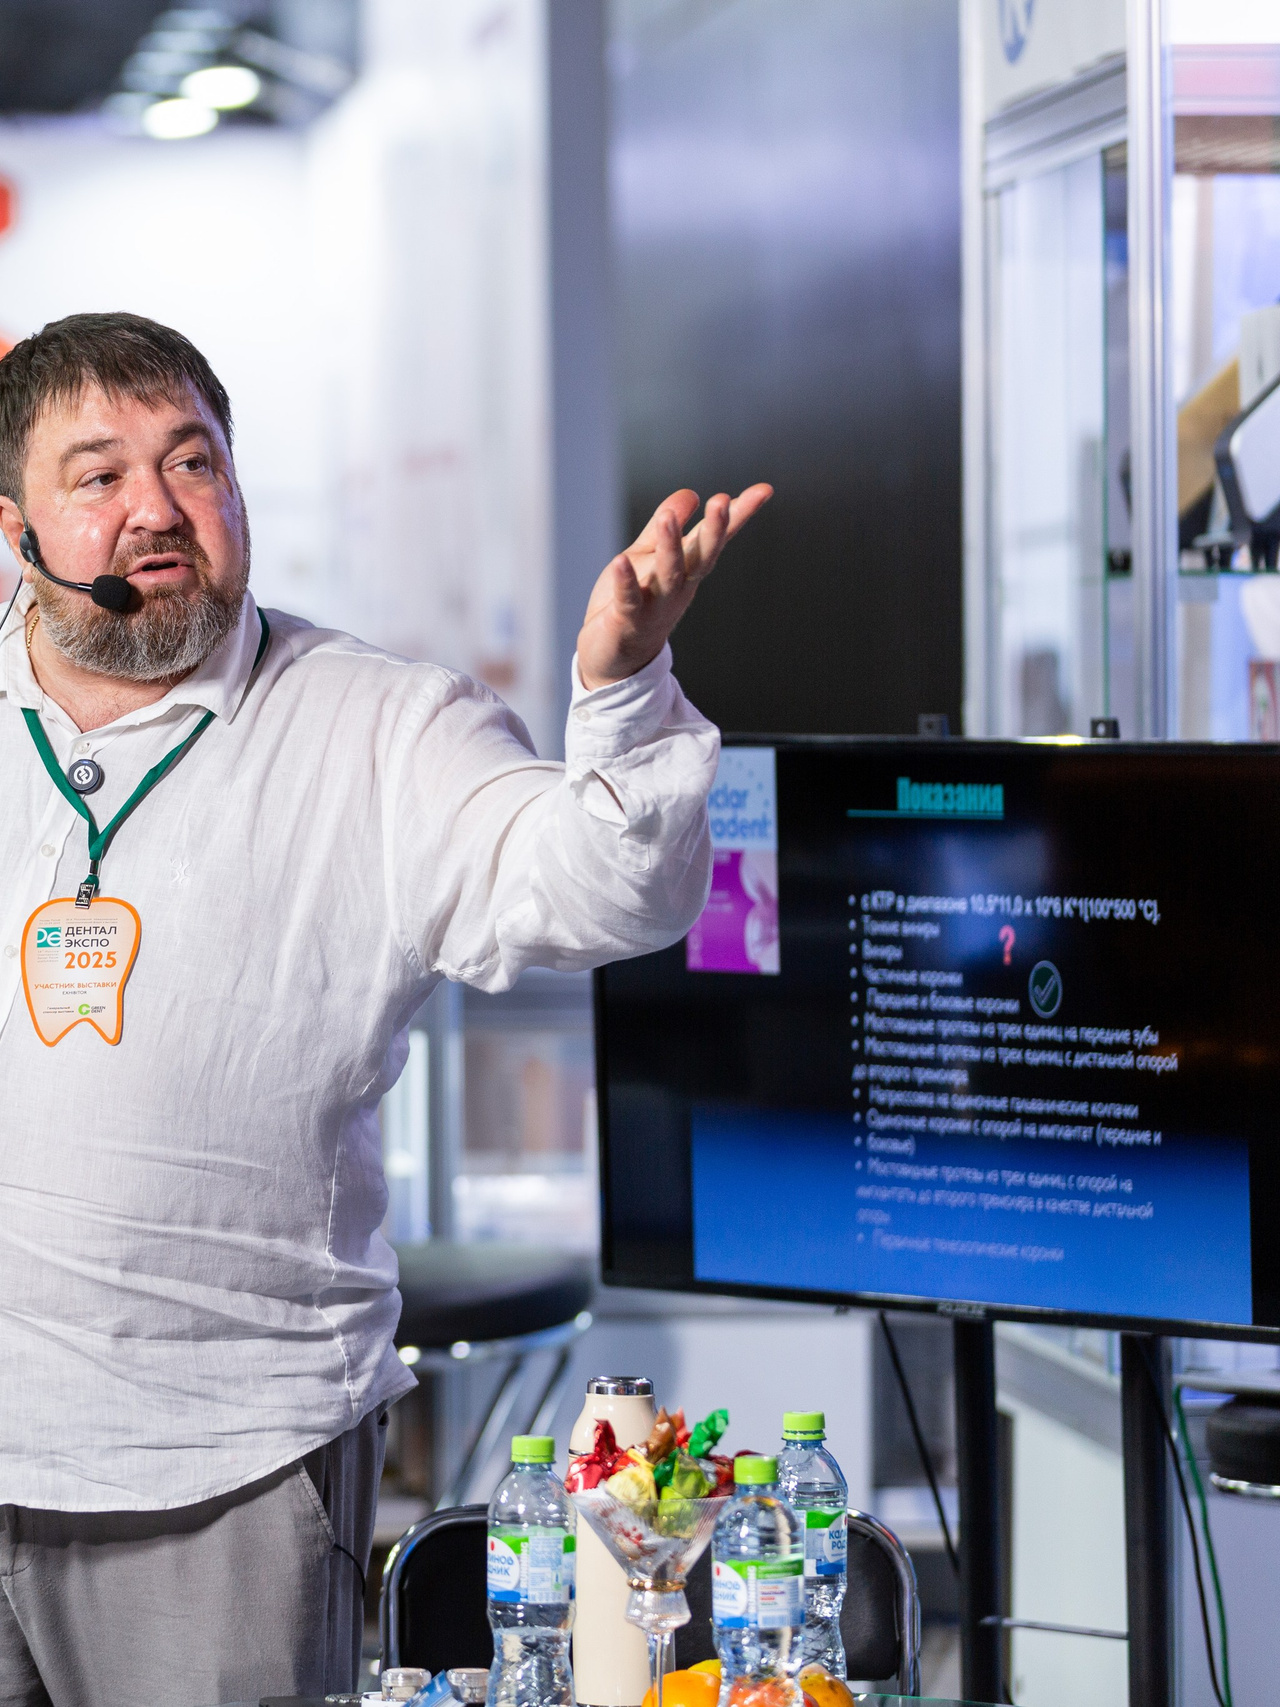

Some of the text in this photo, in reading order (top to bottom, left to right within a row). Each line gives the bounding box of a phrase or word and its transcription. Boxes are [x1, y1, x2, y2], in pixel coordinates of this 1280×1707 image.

[897, 777, 1004, 813] Показания
[906, 895, 968, 914] диапазоне
[65, 926, 117, 937] ДЕНТАЛ
[65, 939, 110, 947] ЭКСПО
[862, 939, 903, 964] Виниры
[65, 951, 117, 969] 2025
[919, 970, 963, 990] коронки
[866, 987, 919, 1011] Передние
[930, 990, 974, 1011] боковые
[976, 997, 1019, 1017] коронки
[936, 1019, 981, 1039] протезы
[1024, 1024, 1063, 1042] единиц
[1064, 1026, 1077, 1042] на
[1079, 1027, 1131, 1047] передние
[1132, 1025, 1159, 1049] зубы
[936, 1043, 981, 1064] протезы
[1024, 1048, 1063, 1067] единиц
[1073, 1050, 1134, 1070] дистальной
[1136, 1053, 1178, 1075] опорой
[951, 1093, 1008, 1112] одиночные
[866, 1108, 926, 1132] Одиночные
[928, 1117, 971, 1136] коронки
[981, 1118, 1021, 1140] опорой
[1096, 1121, 1151, 1147] (передние
[1153, 1130, 1162, 1146] и
